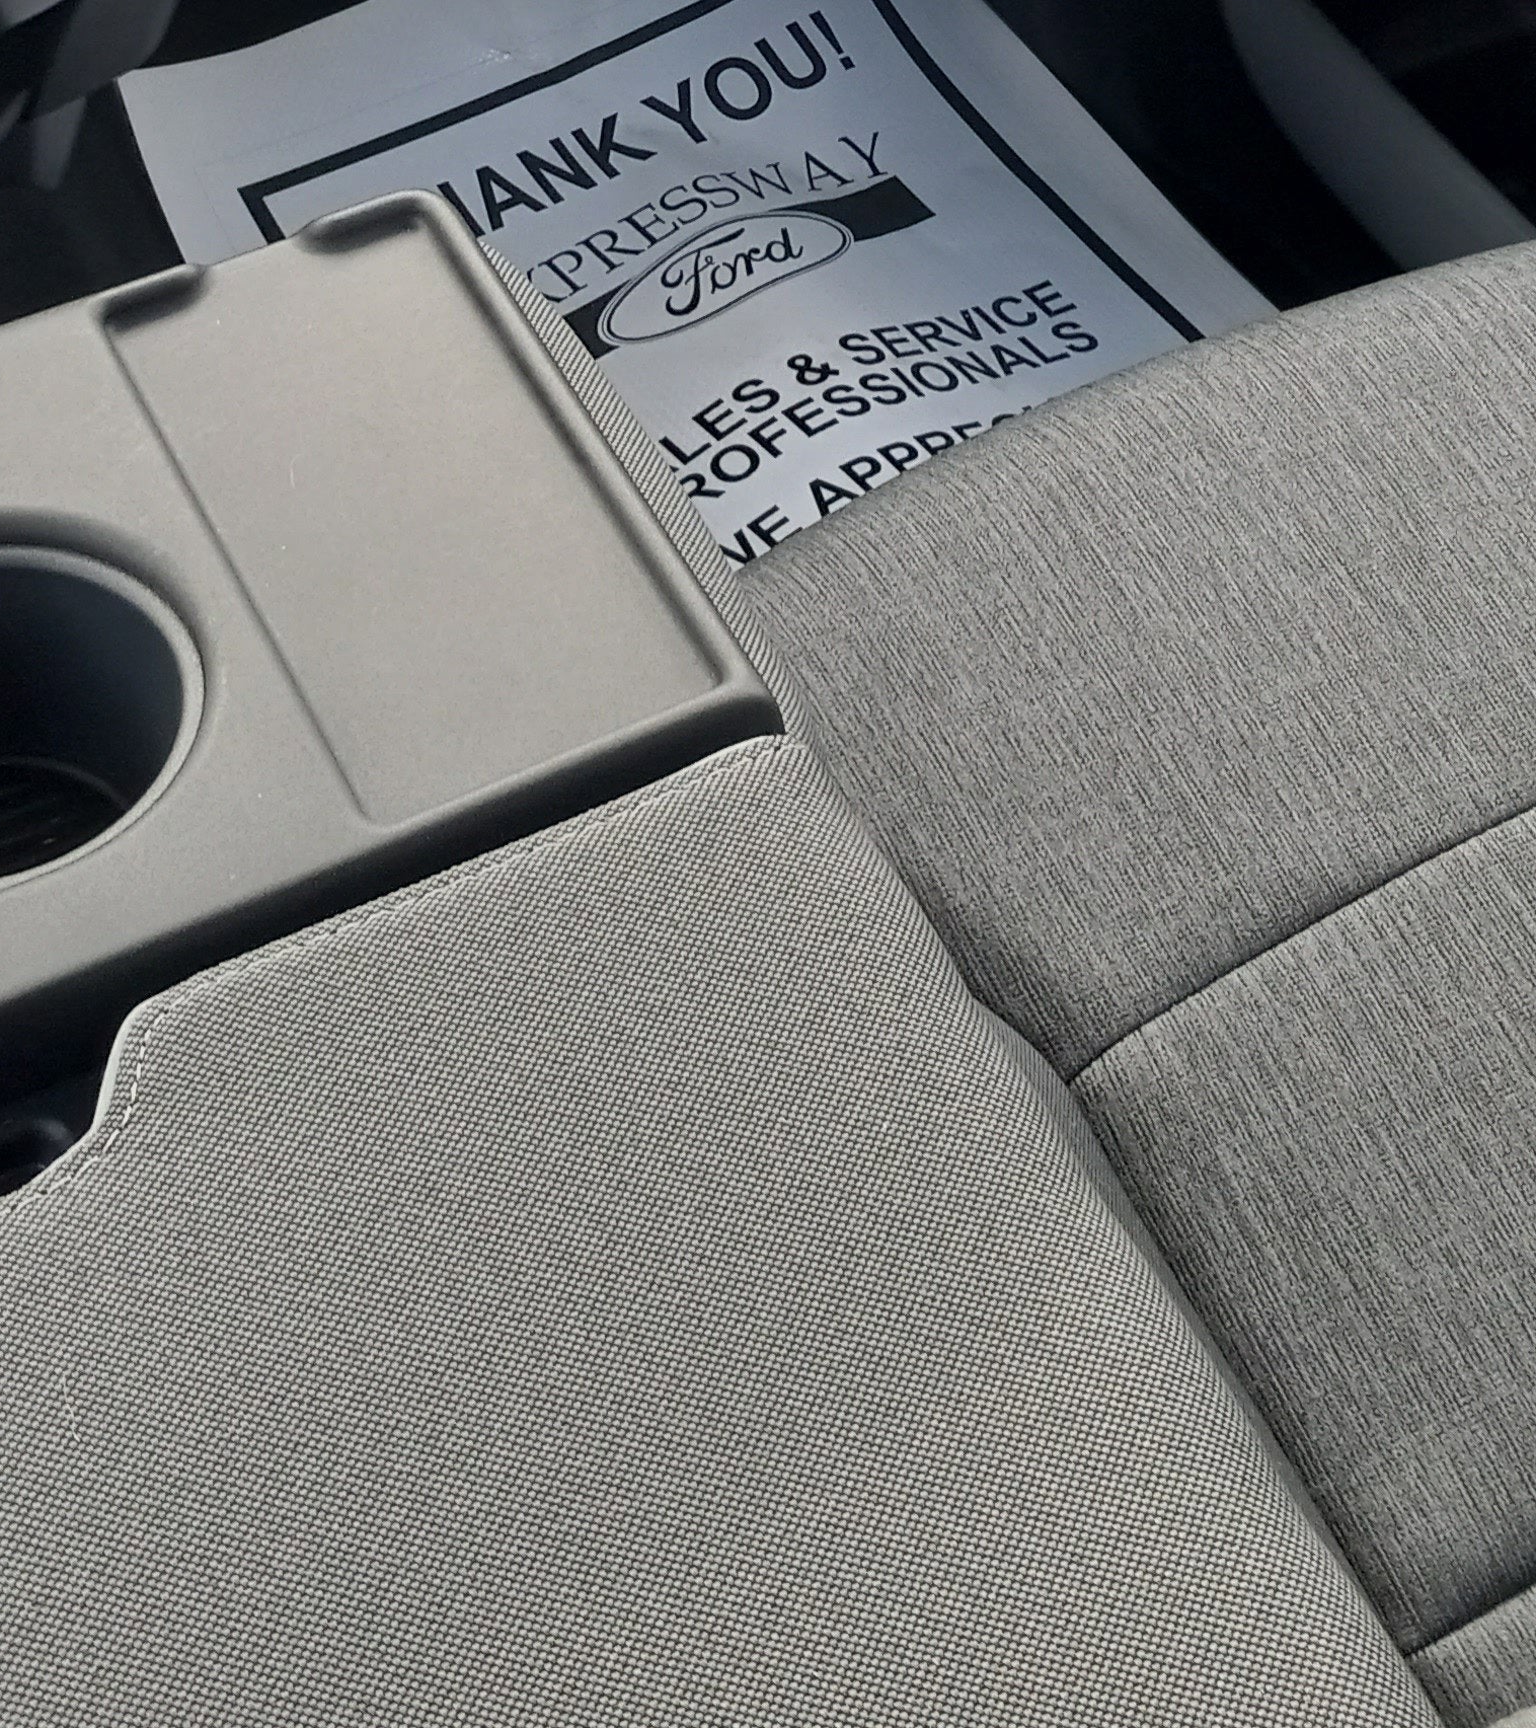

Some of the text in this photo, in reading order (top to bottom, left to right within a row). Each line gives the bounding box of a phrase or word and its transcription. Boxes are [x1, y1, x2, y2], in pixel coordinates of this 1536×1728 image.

[639, 10, 856, 145] YOU!
[660, 226, 804, 316] Ford
[658, 279, 1077, 474] LES & SERVICE
